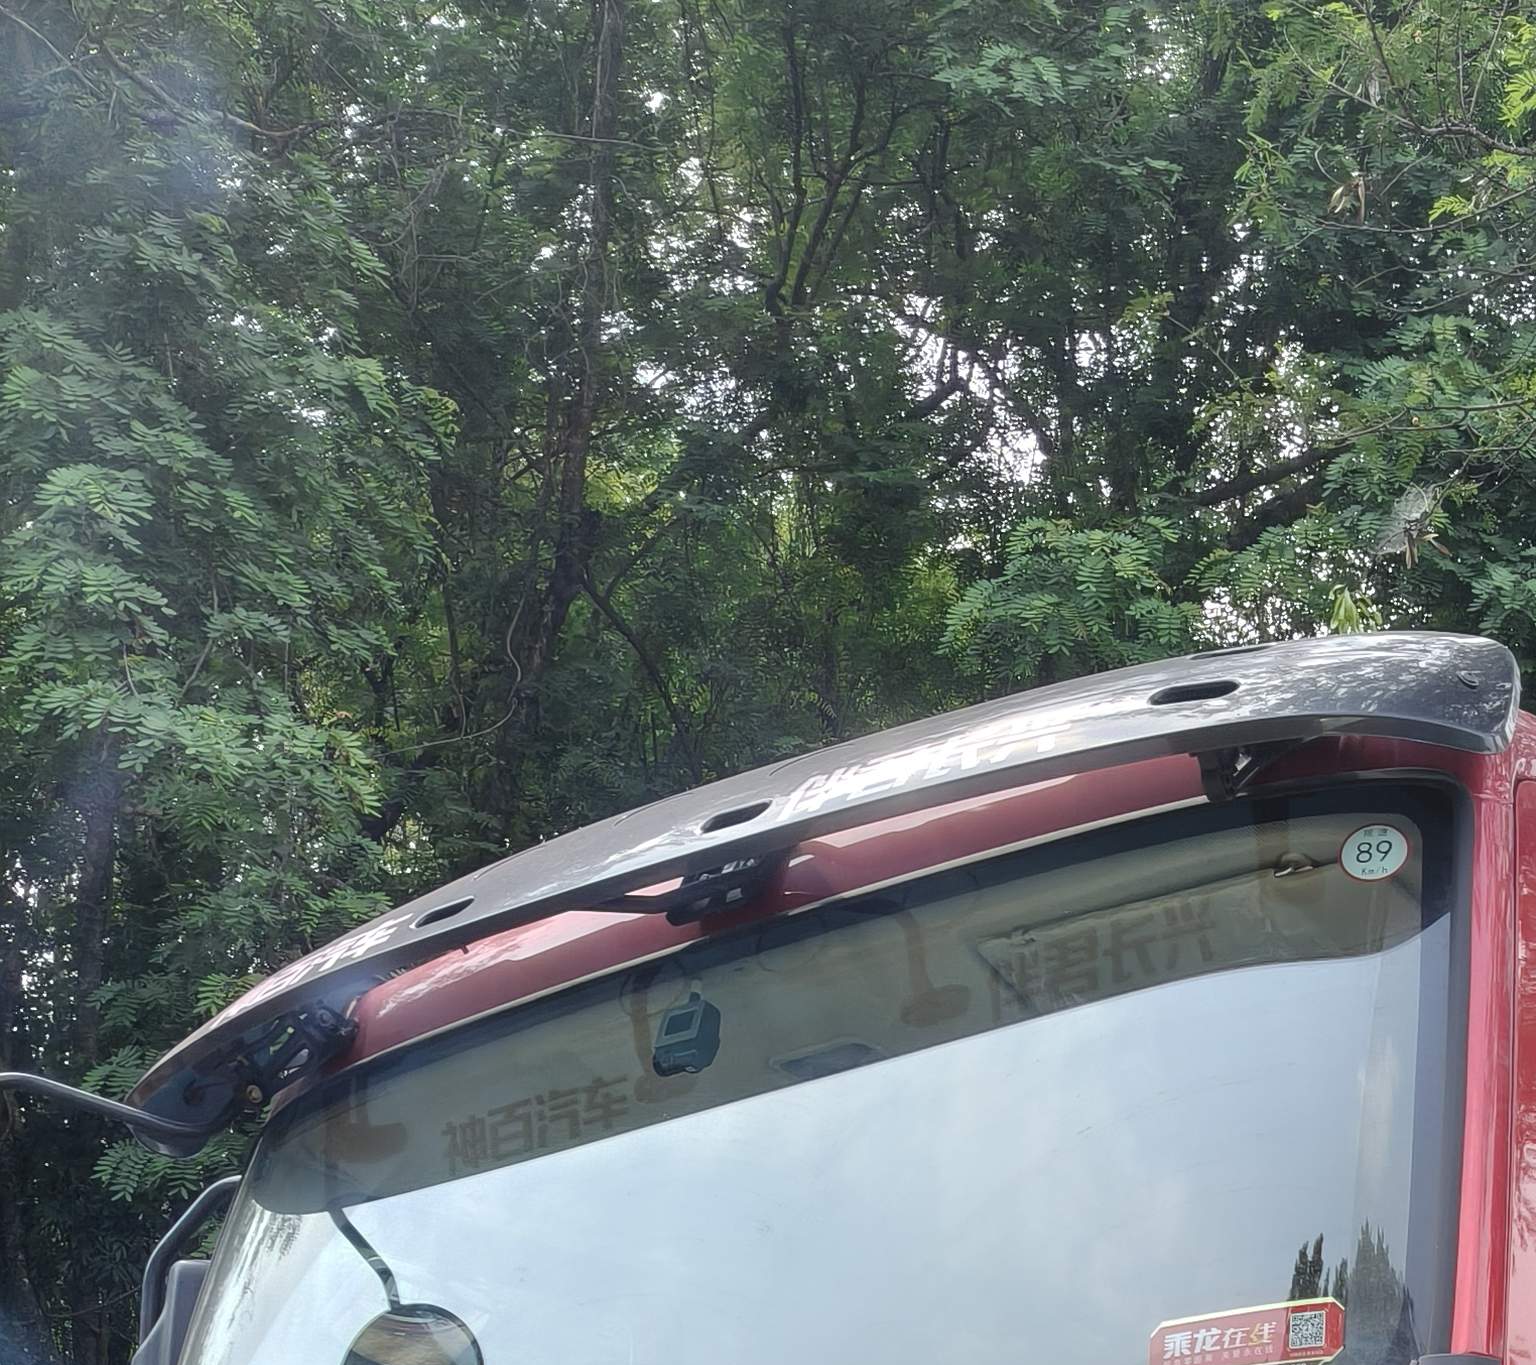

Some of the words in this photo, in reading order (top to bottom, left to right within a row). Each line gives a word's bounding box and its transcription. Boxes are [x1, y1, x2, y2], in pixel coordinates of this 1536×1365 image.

[1356, 840, 1393, 863] 89
[1163, 1321, 1277, 1359] 乘龙在线
